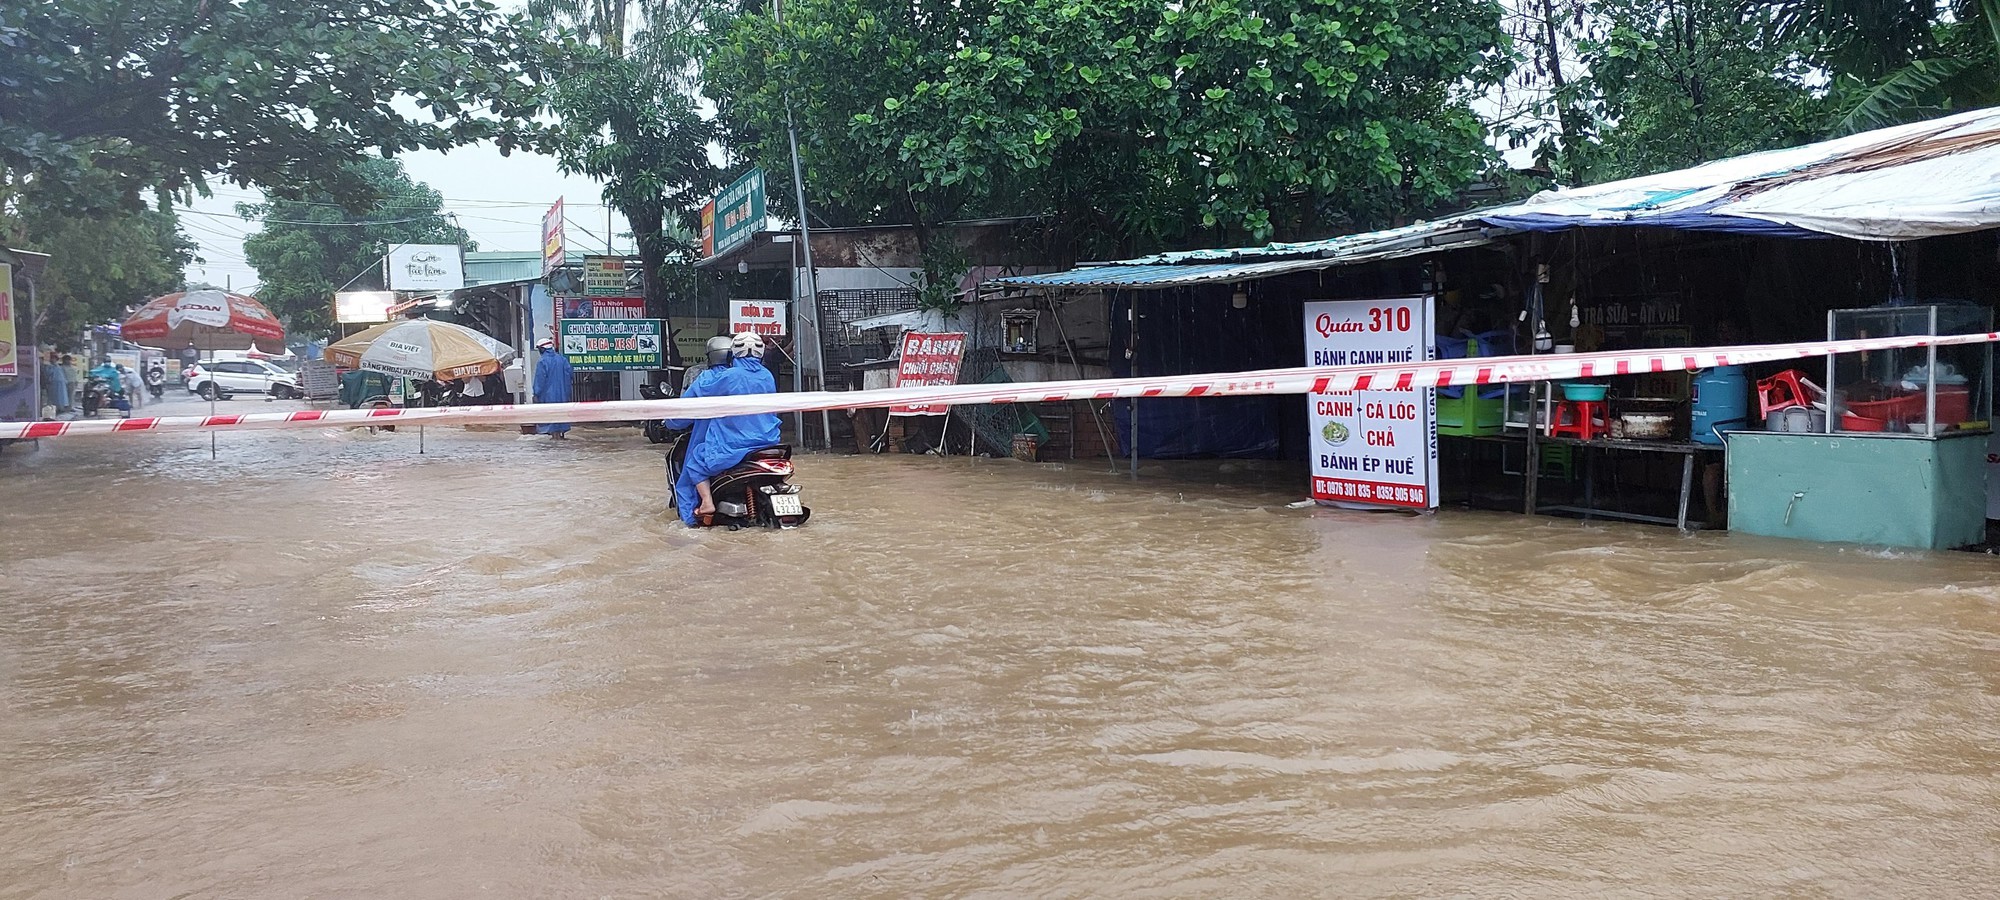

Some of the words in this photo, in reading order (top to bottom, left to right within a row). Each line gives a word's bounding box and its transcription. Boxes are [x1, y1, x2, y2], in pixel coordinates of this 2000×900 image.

[174, 303, 222, 313] VEDAN
[762, 307, 775, 318] XE
[568, 322, 594, 334] CHUYÊN
[595, 321, 609, 334] SỬA
[630, 324, 638, 334] XE
[1315, 312, 1365, 338] Quán
[1368, 306, 1411, 332] 310
[390, 341, 403, 350] BIA
[586, 338, 598, 350] XE
[599, 338, 609, 350] GA
[614, 338, 625, 350] XE
[625, 333, 638, 350] SỐ
[906, 338, 962, 356] BÁNH
[569, 355, 583, 364] MUA
[597, 355, 612, 364] TRAO
[624, 355, 632, 363] XE
[1314, 348, 1346, 366] BÁNH
[1350, 350, 1384, 365] CANH
[453, 367, 465, 377] BIA
[1317, 401, 1353, 417] CANH
[1366, 400, 1384, 419] CÁ
[1389, 401, 1416, 420] LÓC
[1367, 426, 1395, 447] CHẢ
[1429, 420, 1437, 459] BÁNH
[1321, 452, 1358, 471] BÁNH
[1362, 455, 1380, 472] ÉP
[1385, 456, 1415, 475] HUẾ
[1316, 480, 1326, 494] ĐT:
[1327, 482, 1343, 497] 0976
[1344, 483, 1357, 497] 381
[1358, 484, 1371, 498] 835
[1376, 485, 1394, 501] 0352
[1395, 487, 1409, 502] 905
[1409, 488, 1424, 504] 946
